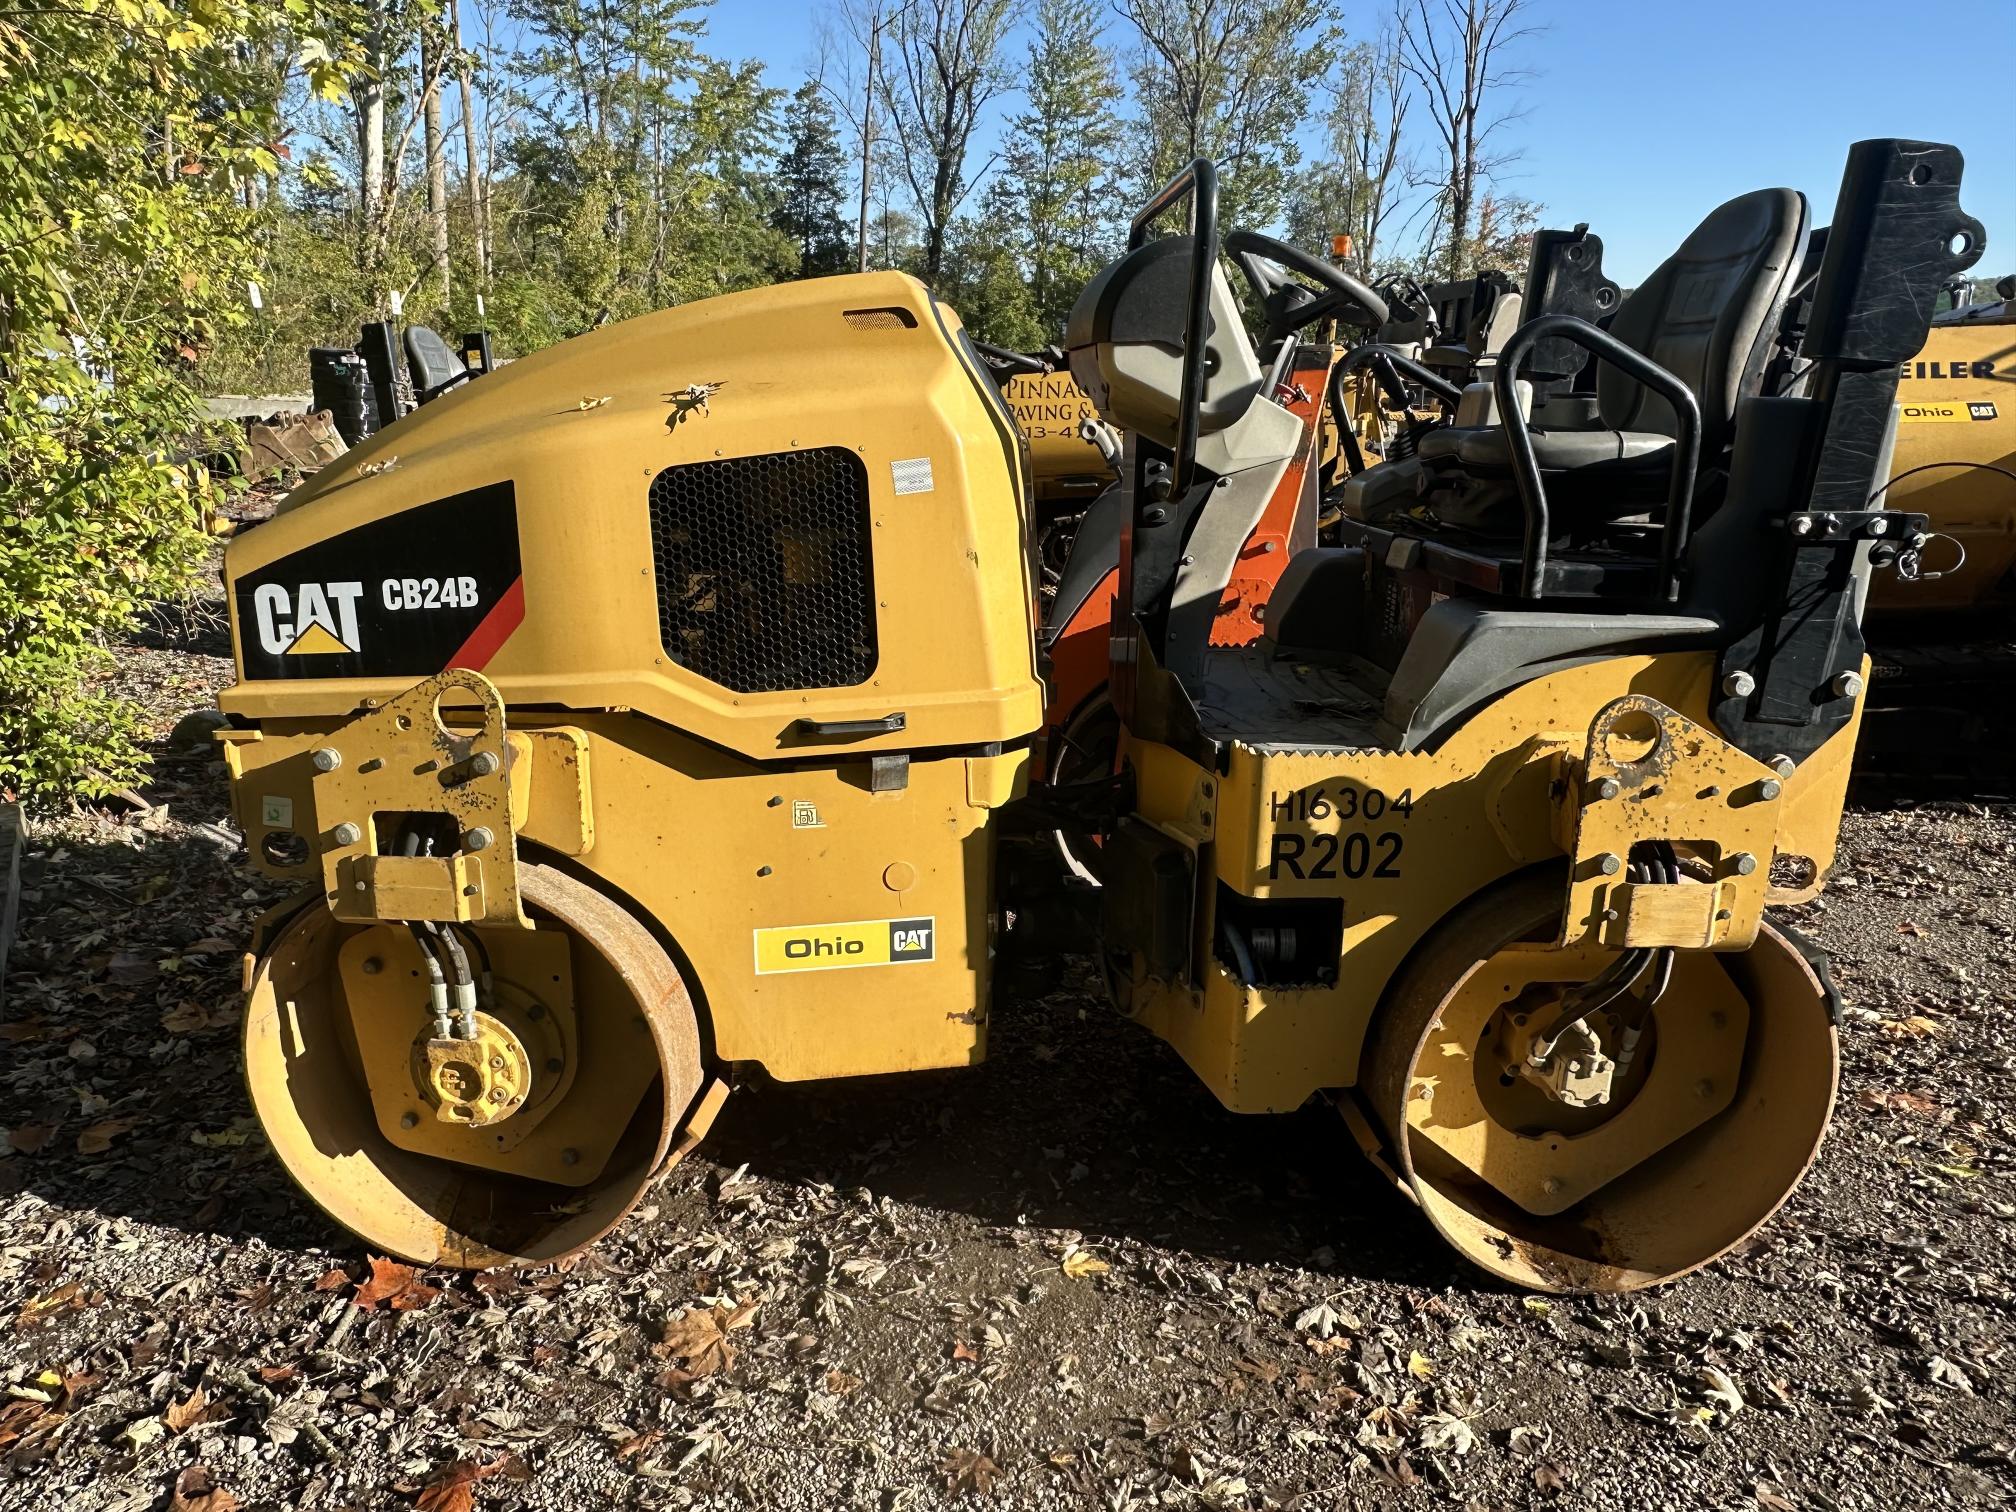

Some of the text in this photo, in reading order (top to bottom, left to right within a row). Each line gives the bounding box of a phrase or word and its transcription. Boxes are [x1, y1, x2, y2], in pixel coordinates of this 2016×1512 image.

[1903, 405, 1995, 417] Ohio CAT
[254, 576, 479, 655] CAT CB24B
[1271, 787, 1413, 822] H16304
[1269, 832, 1403, 880] R202
[784, 929, 932, 959] Ohio CAT
